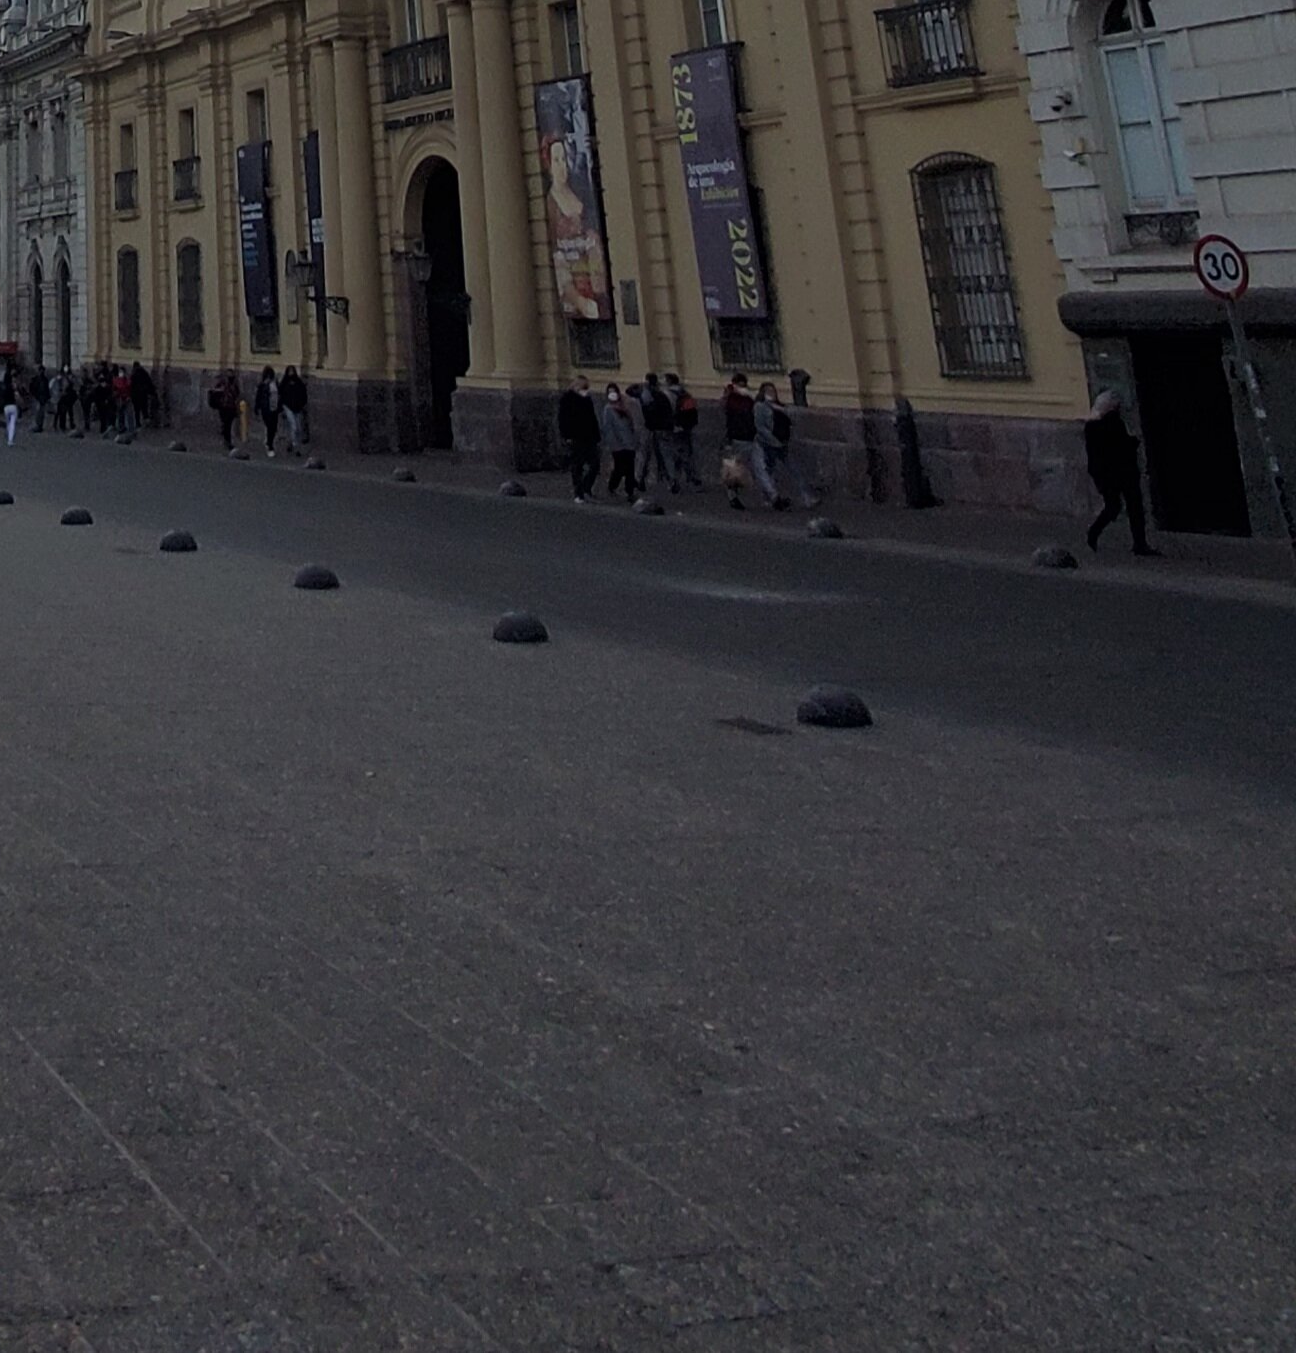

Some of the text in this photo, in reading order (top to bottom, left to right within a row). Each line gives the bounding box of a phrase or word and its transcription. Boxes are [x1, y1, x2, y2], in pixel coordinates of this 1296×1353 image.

[672, 64, 699, 145] 1873
[727, 217, 759, 310] 2022
[1204, 252, 1240, 281] 30
